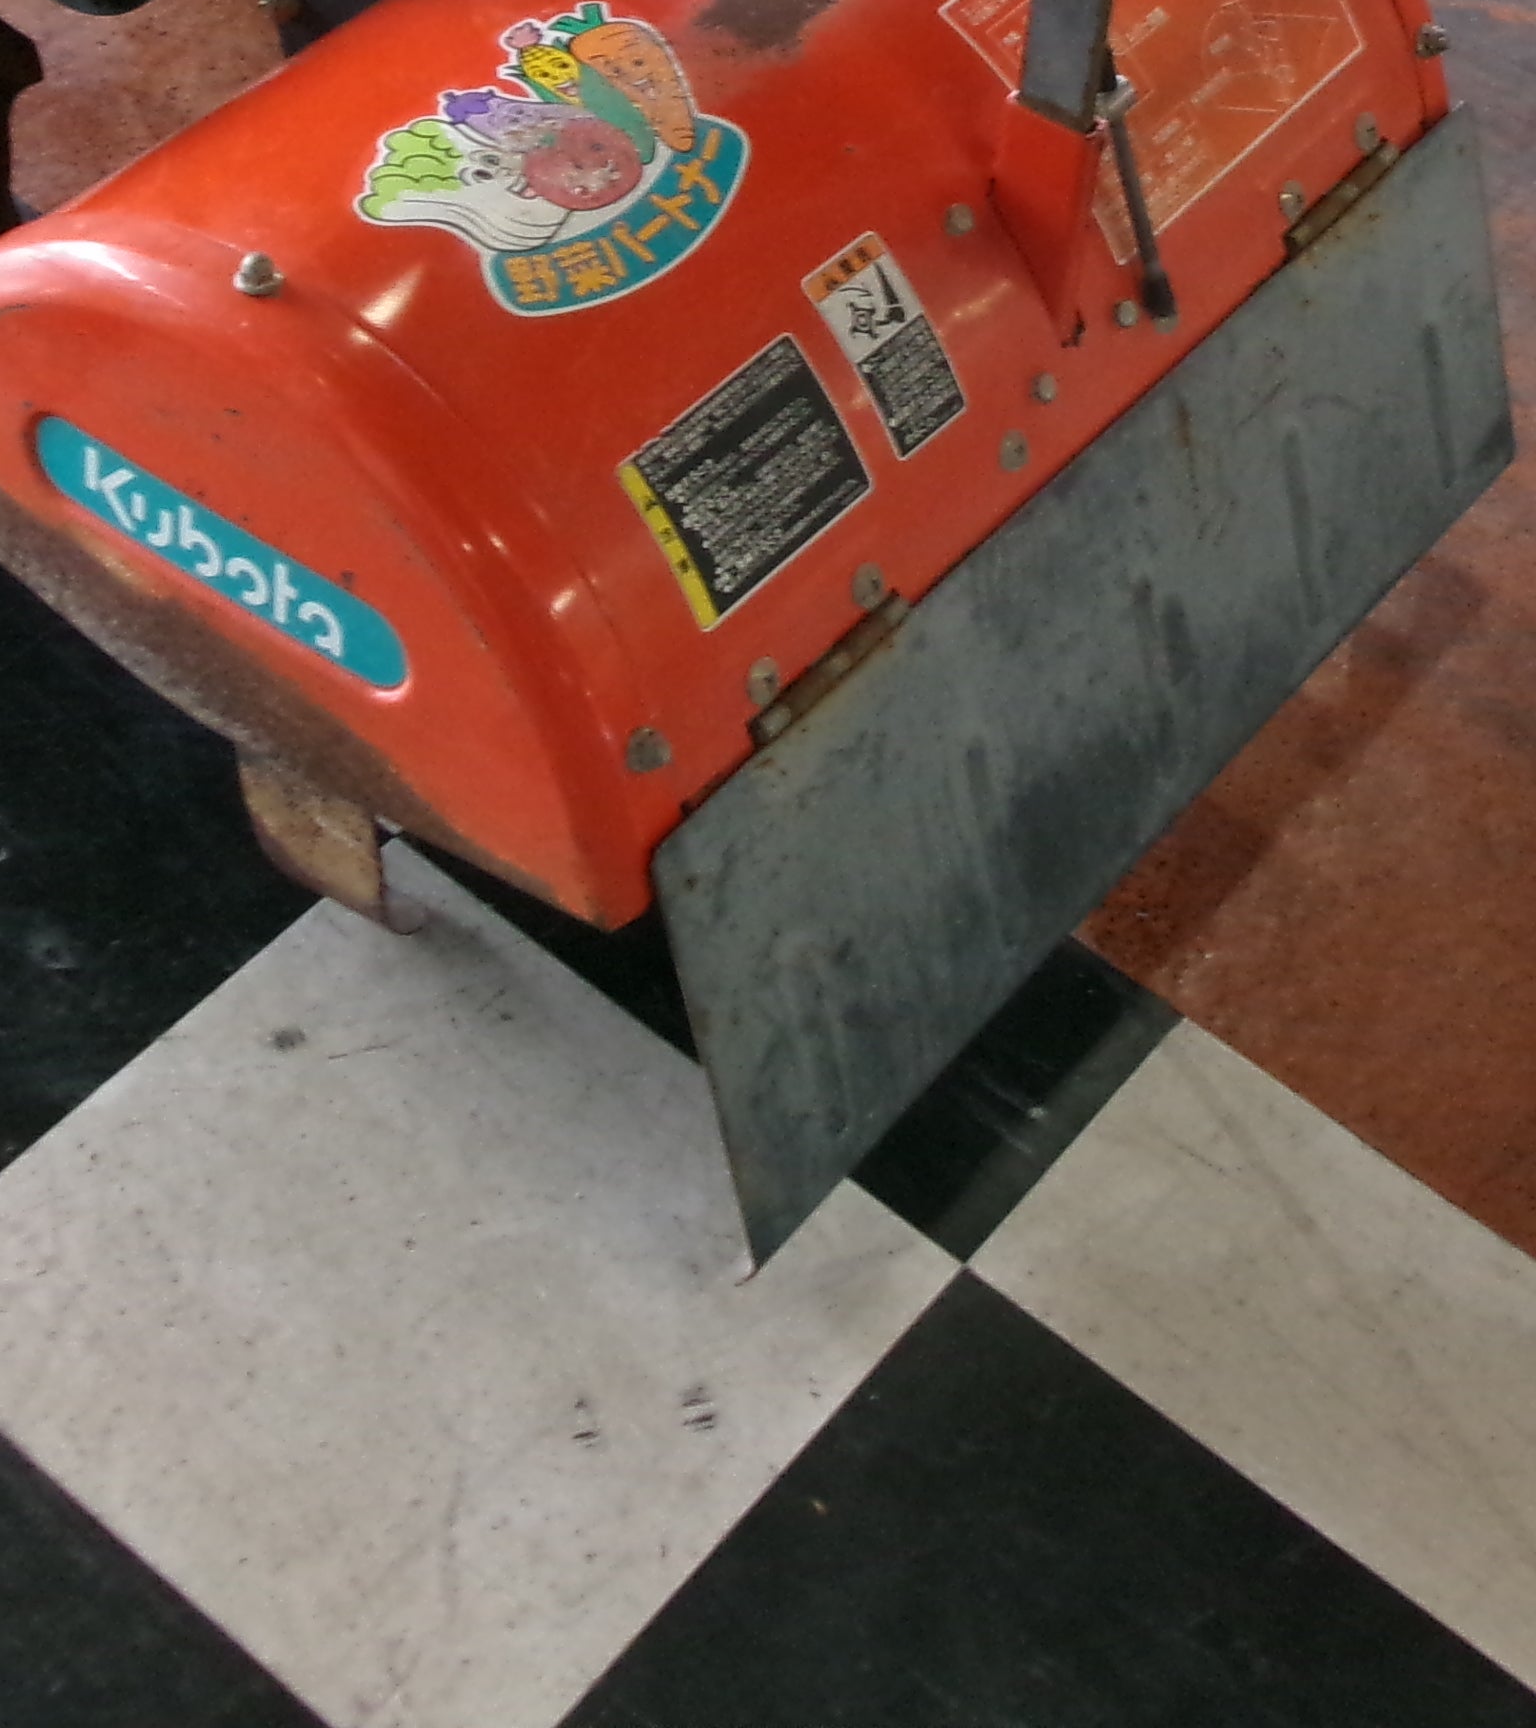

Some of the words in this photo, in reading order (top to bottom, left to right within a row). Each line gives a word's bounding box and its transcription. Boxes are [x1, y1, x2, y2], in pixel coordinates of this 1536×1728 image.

[503, 127, 722, 305] 野菜パートナー
[81, 445, 346, 659] Kubota
